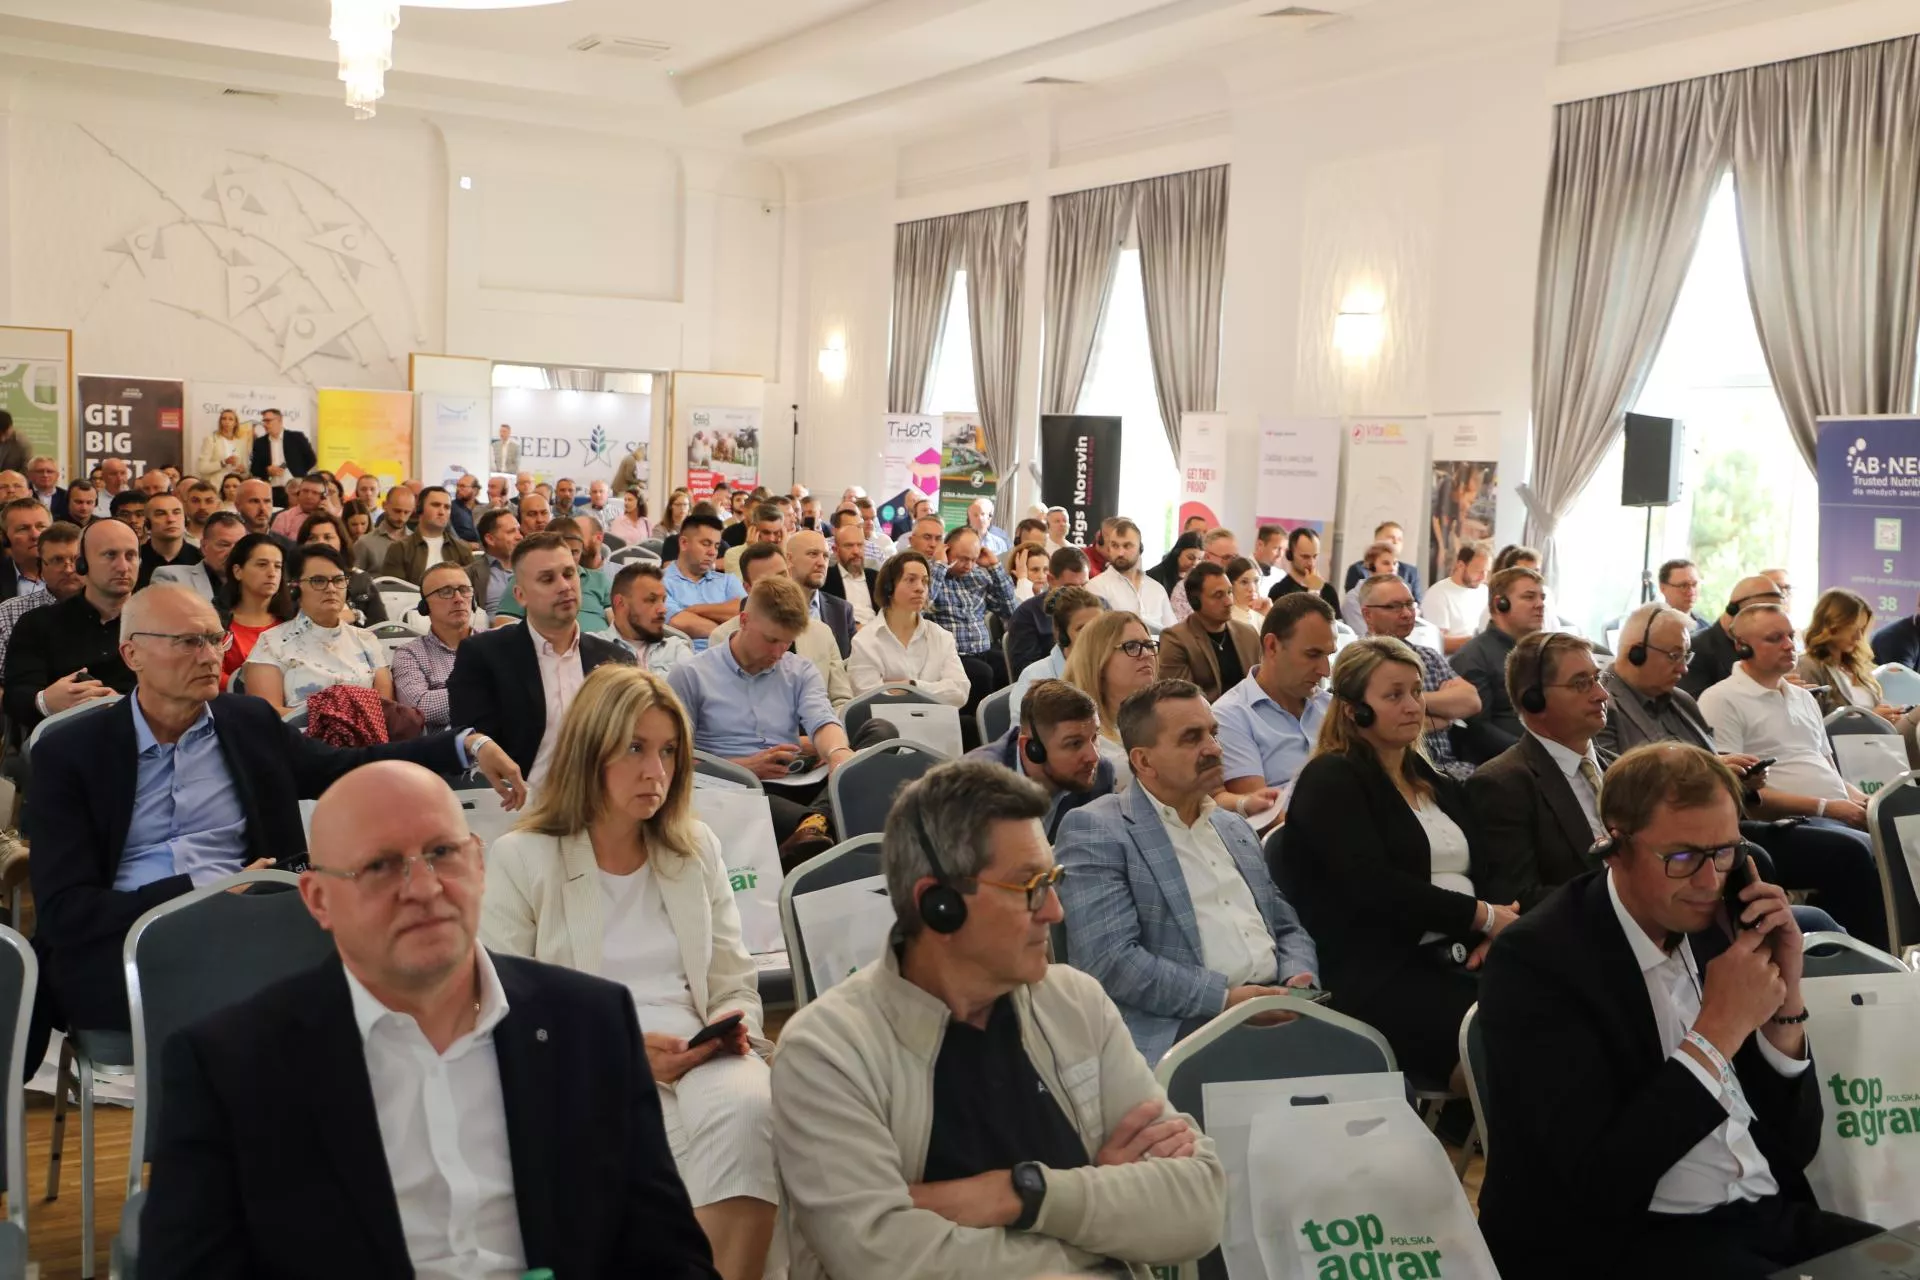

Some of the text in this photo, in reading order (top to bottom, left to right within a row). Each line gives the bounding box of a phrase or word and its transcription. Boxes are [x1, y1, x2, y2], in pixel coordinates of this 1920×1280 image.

[85, 404, 132, 426] GET
[85, 431, 132, 453] BIG
[510, 436, 571, 458] EED
[1073, 436, 1088, 505] Norsvin
[1852, 475, 1888, 487] Trusted
[1883, 558, 1894, 574] 5
[1878, 596, 1897, 611] 38
[1828, 1073, 1883, 1109] top
[1301, 1213, 1435, 1253] top POLSKA
